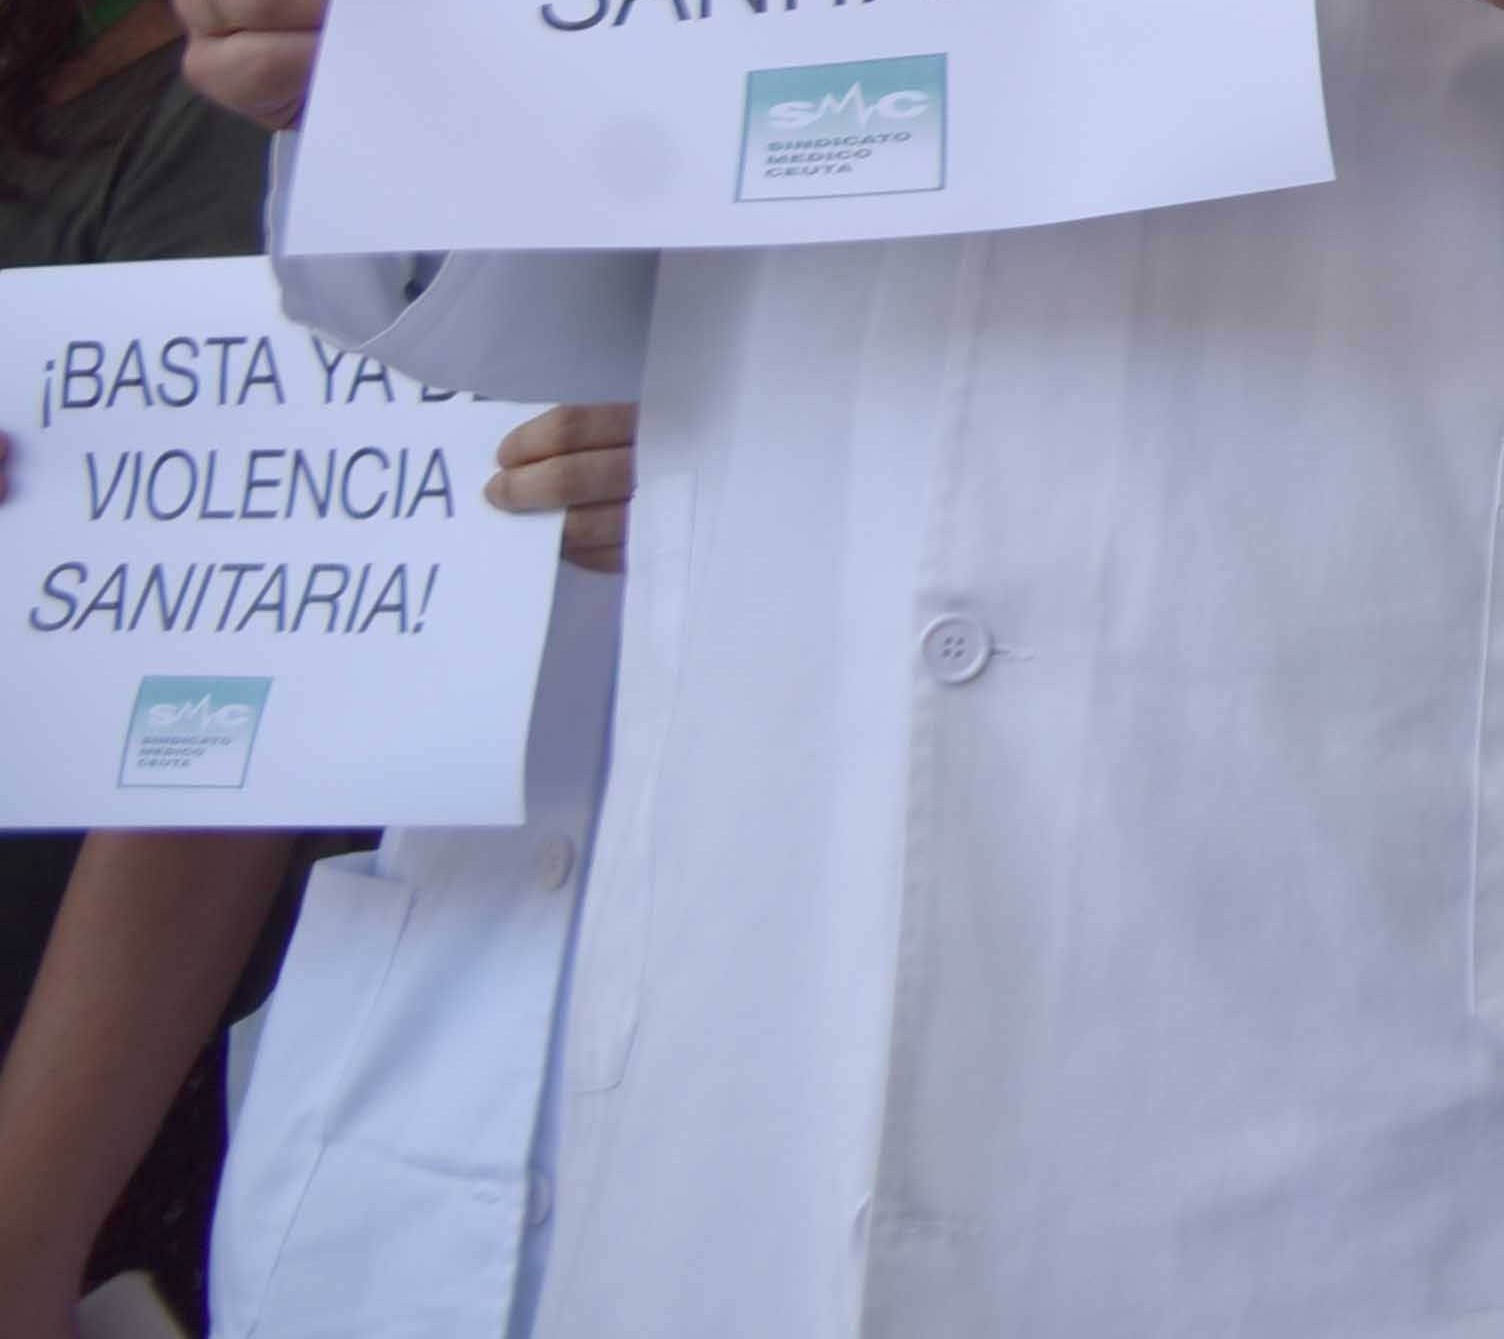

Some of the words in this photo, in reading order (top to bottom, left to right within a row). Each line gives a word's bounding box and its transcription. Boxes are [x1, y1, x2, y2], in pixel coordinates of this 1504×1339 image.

[766, 148, 872, 165] MEDICO
[767, 131, 912, 151] SINDICATO
[764, 163, 855, 178] CEUTA
[40, 336, 286, 428] ¡BASTA
[84, 447, 456, 522] VIOLENCIA
[28, 562, 440, 635] SANITARIA!
